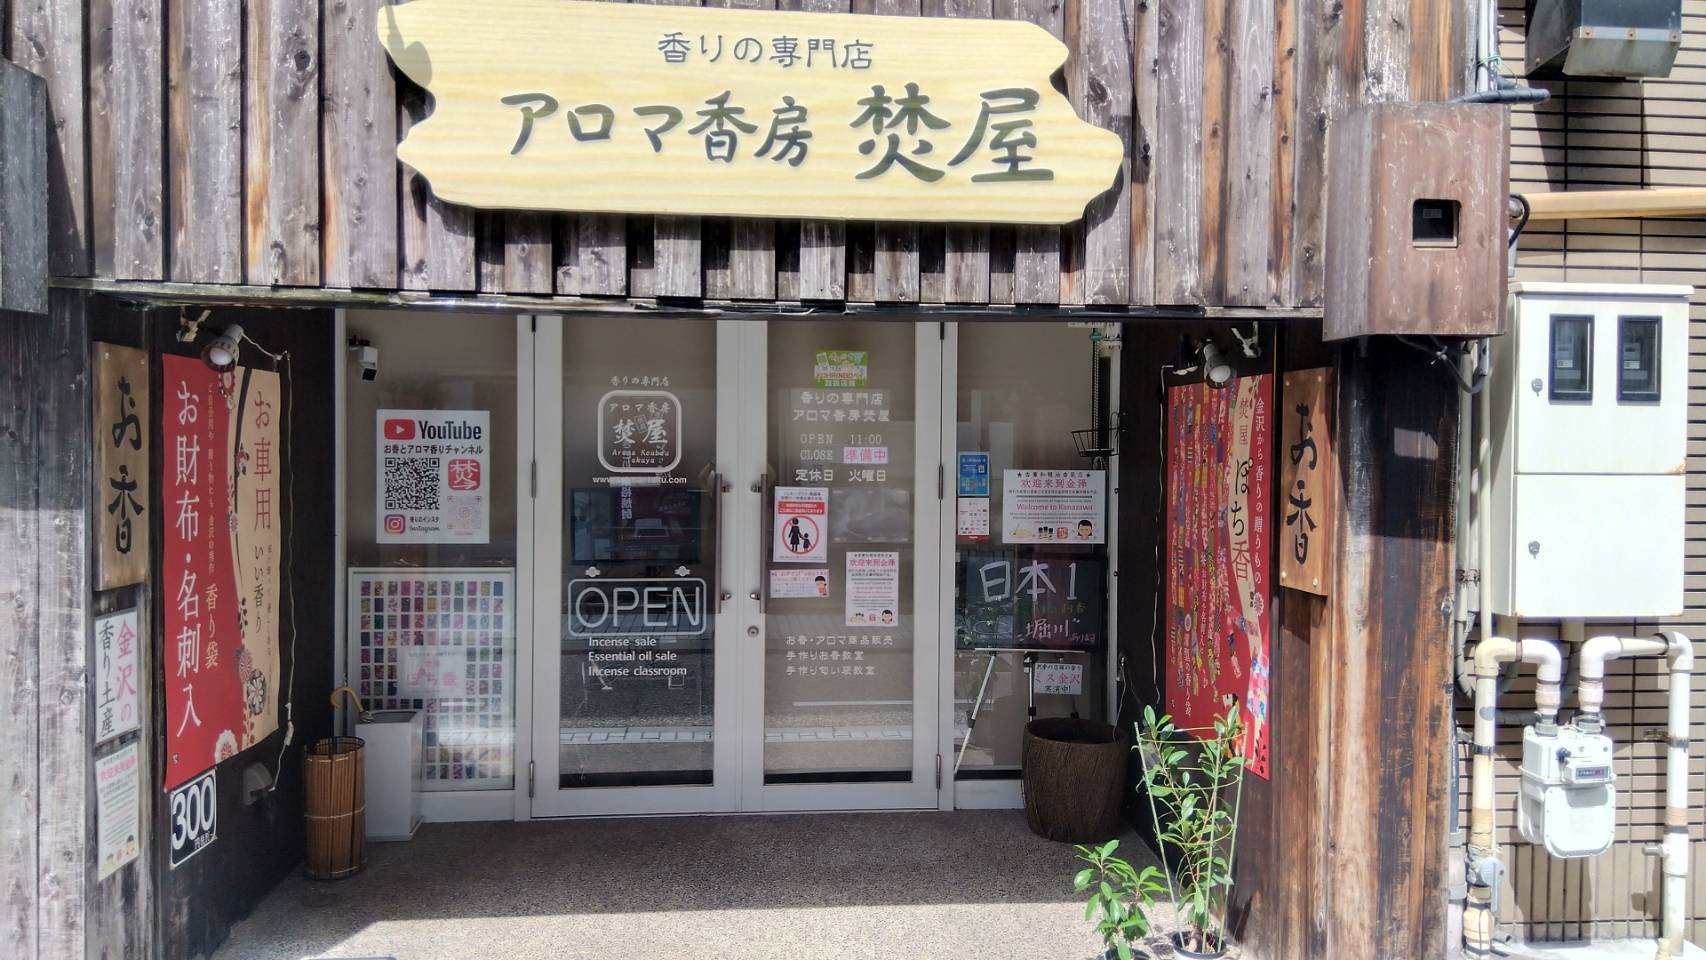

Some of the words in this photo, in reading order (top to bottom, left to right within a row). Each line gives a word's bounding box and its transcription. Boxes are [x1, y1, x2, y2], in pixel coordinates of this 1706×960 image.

[657, 32, 874, 70] 香りの専門店
[500, 89, 813, 168] アロマ香房
[850, 82, 1055, 185] 焚屋
[799, 391, 884, 406] 香りの専門店
[418, 420, 482, 440] YouTube
[612, 418, 669, 445] 焚屋
[799, 433, 834, 445] OPEN
[850, 433, 882, 445] 11:00
[108, 376, 145, 555] お香
[253, 390, 273, 532] お車用
[799, 448, 834, 461] CLOSE
[795, 469, 834, 482] 定休日
[848, 469, 887, 482] 火曜日
[1287, 402, 1318, 565] お香
[1016, 503, 1049, 511] Welcome
[1050, 503, 1058, 511] to
[1058, 503, 1093, 511] Kanazawa
[575, 586, 701, 628] OPEN
[205, 582, 219, 670] 香り袋
[588, 637, 630, 647] Incense
[634, 637, 657, 647] sale
[116, 618, 137, 723] 金沢の
[588, 651, 636, 661] Essential
[638, 651, 652, 661] oil
[655, 651, 678, 661] sale
[588, 666, 630, 676] Incense
[633, 666, 688, 676] classroom
[98, 619, 116, 738] 香り土産
[172, 775, 215, 851] 300
